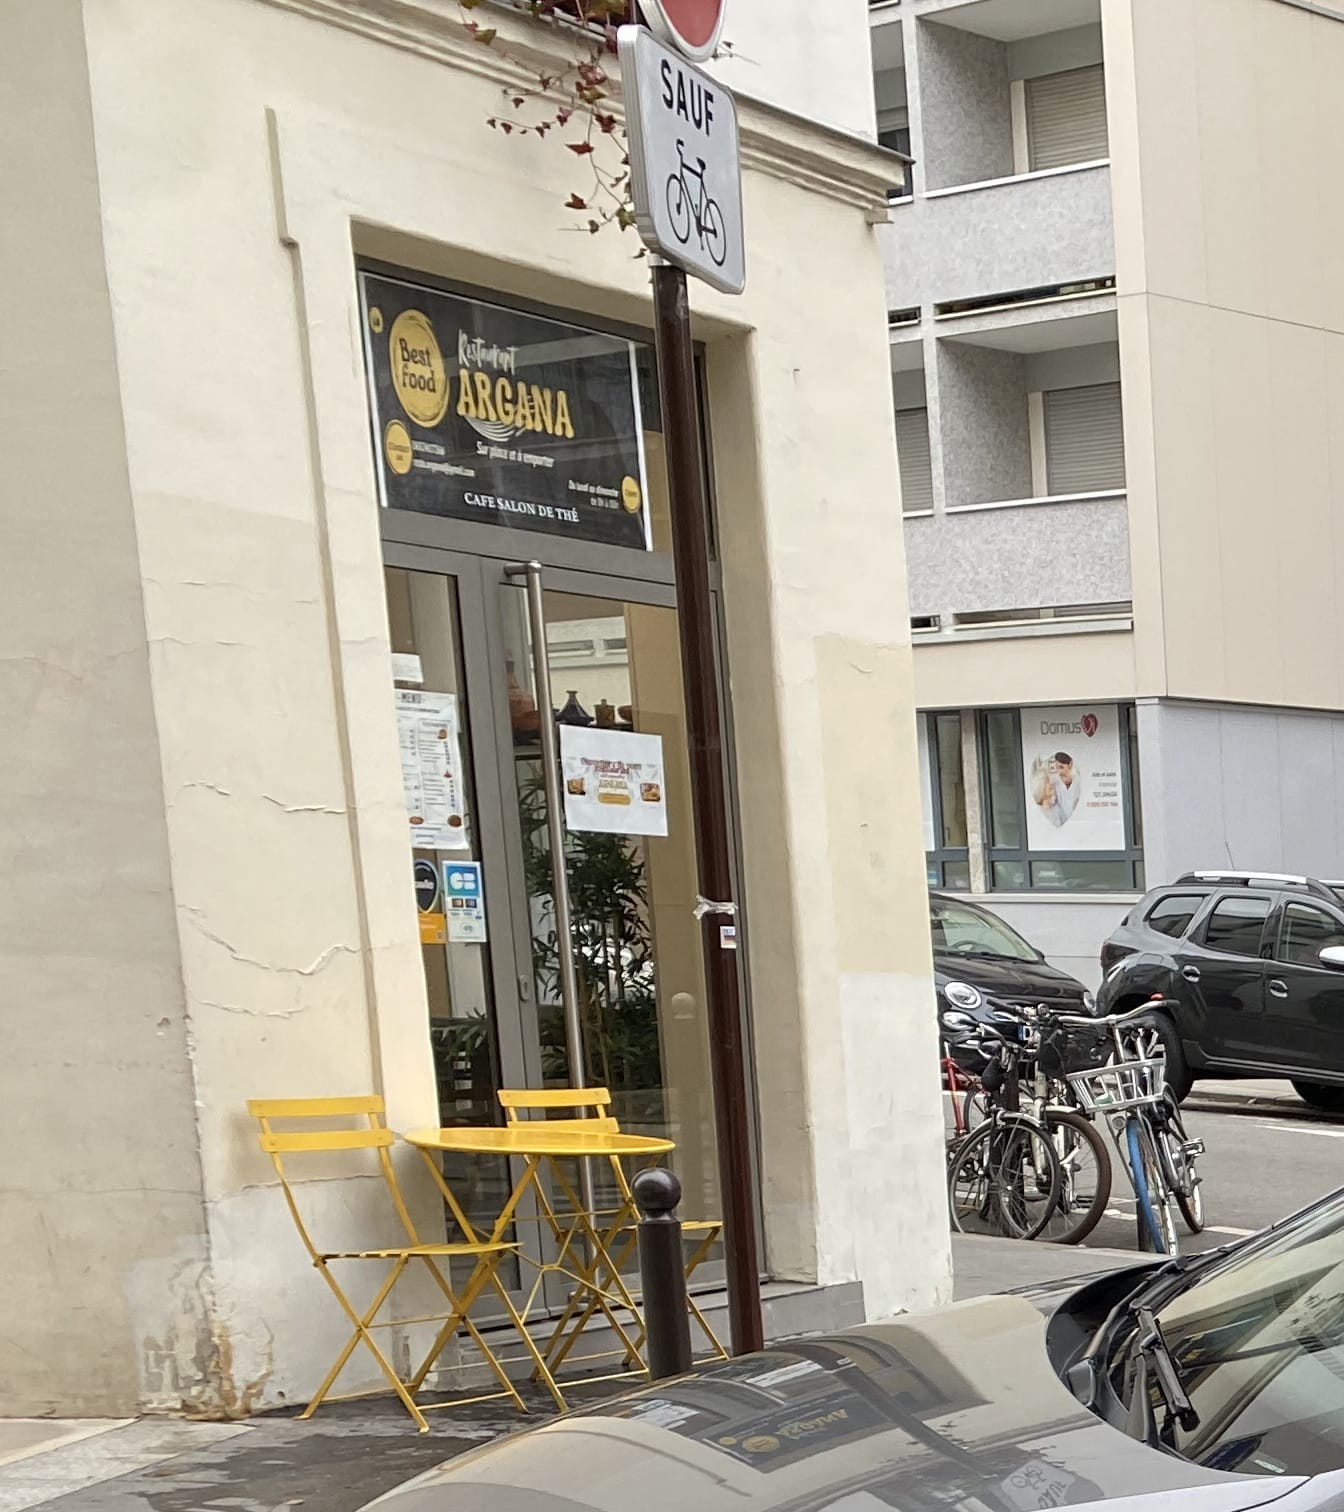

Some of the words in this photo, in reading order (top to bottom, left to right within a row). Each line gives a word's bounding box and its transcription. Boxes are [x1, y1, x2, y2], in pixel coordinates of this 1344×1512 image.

[660, 58, 715, 138] SAUF
[399, 338, 432, 367] Best
[402, 365, 436, 393] food
[456, 368, 574, 438] ARGANA
[464, 492, 496, 508] CAFE
[497, 498, 536, 515] SALON
[537, 504, 554, 518] DE
[554, 508, 579, 522] THÉ
